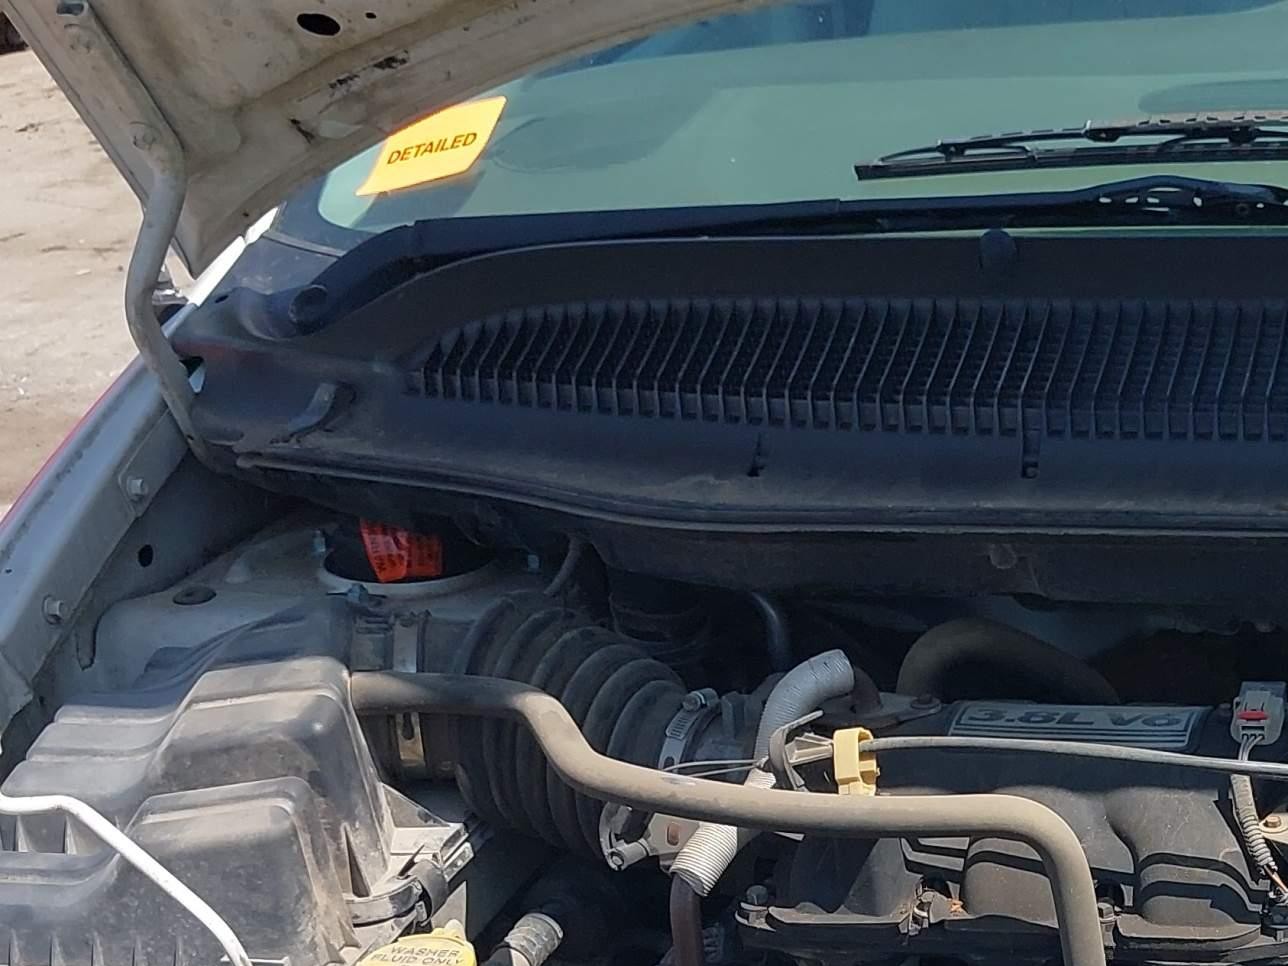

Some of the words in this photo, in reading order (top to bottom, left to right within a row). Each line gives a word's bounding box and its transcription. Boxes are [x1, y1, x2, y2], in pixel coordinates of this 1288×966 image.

[387, 133, 477, 165] DETAILED
[968, 708, 1094, 725] 3.8L
[1107, 711, 1182, 728] V6
[391, 946, 460, 956] WASHER
[371, 954, 418, 963] FLUID
[422, 957, 463, 966] ONLY
